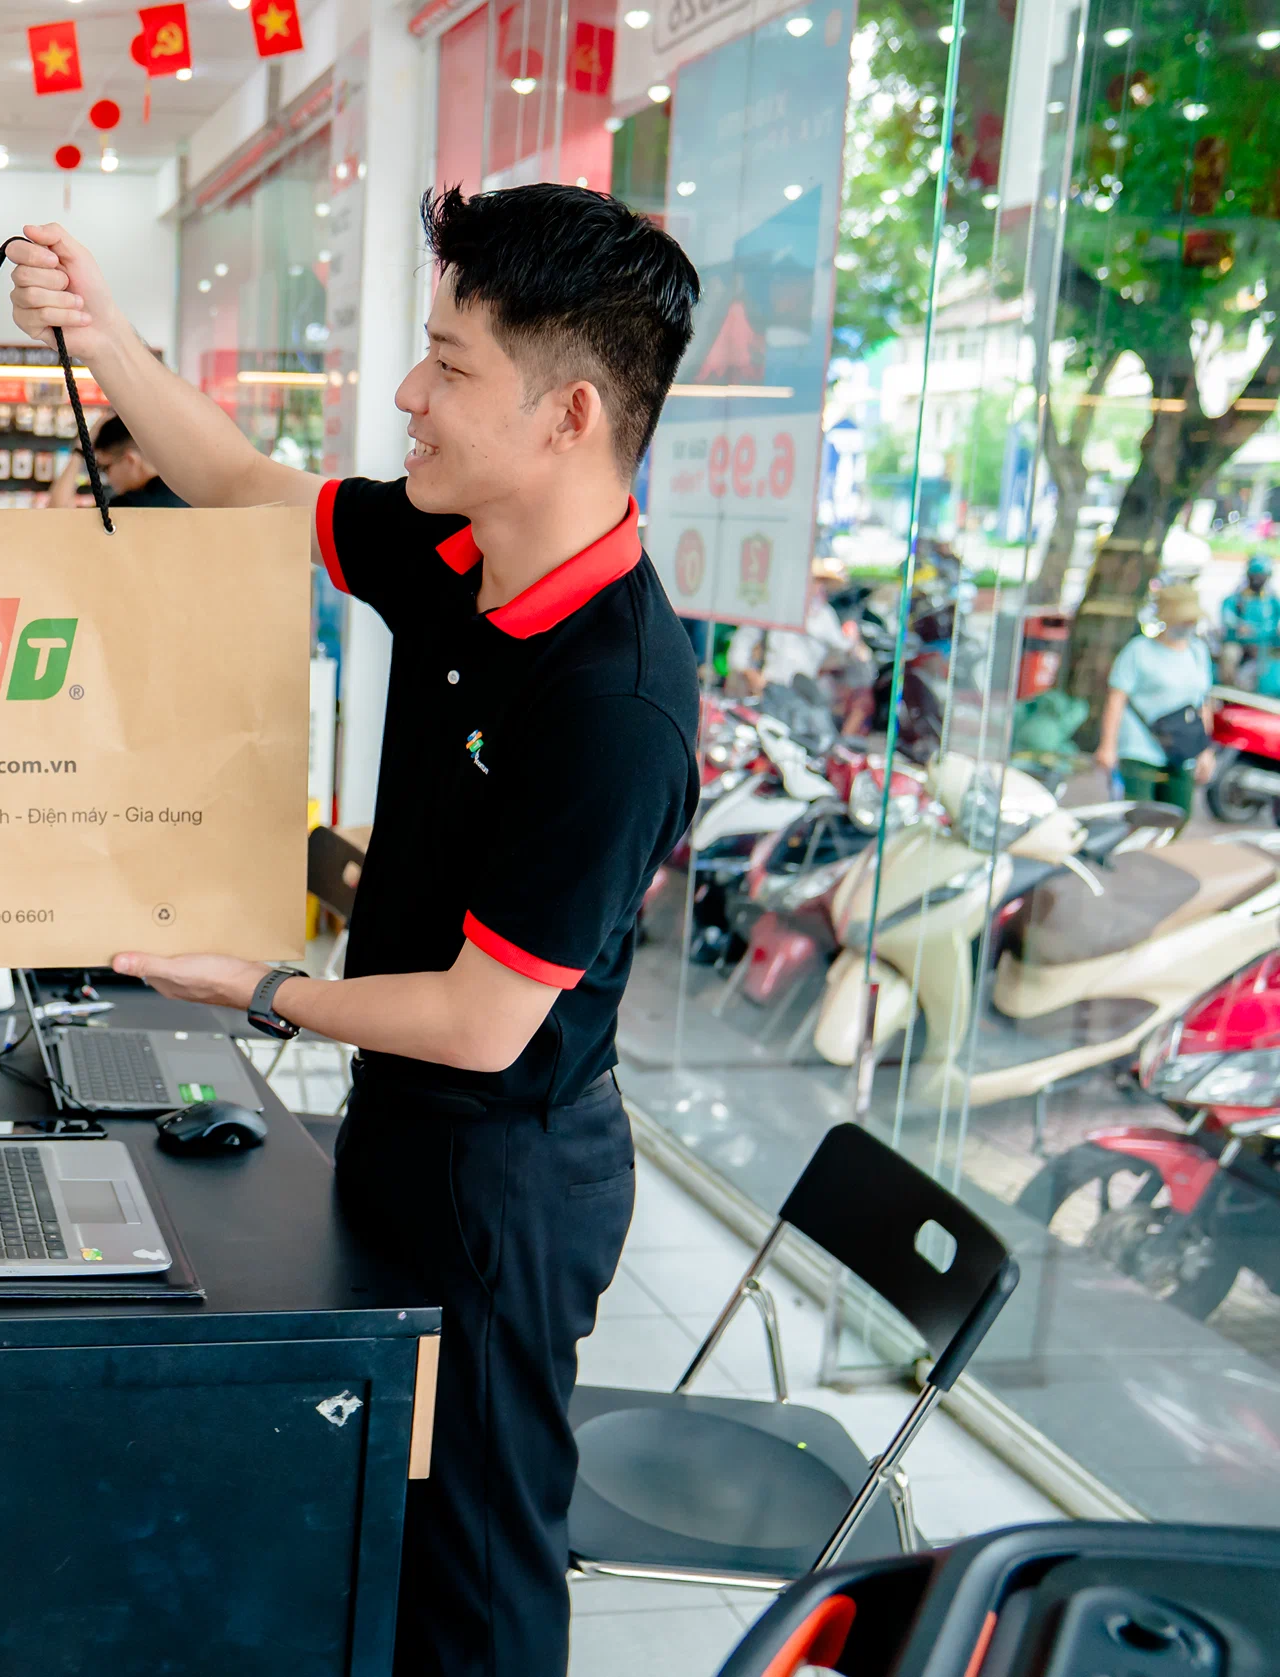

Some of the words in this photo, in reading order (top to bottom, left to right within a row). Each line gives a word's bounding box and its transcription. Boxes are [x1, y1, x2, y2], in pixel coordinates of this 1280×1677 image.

[28, 808, 67, 827] Điện
[72, 807, 108, 826] máy
[125, 806, 154, 823] Gia
[158, 807, 203, 827] dụng
[15, 910, 54, 924] 6601
